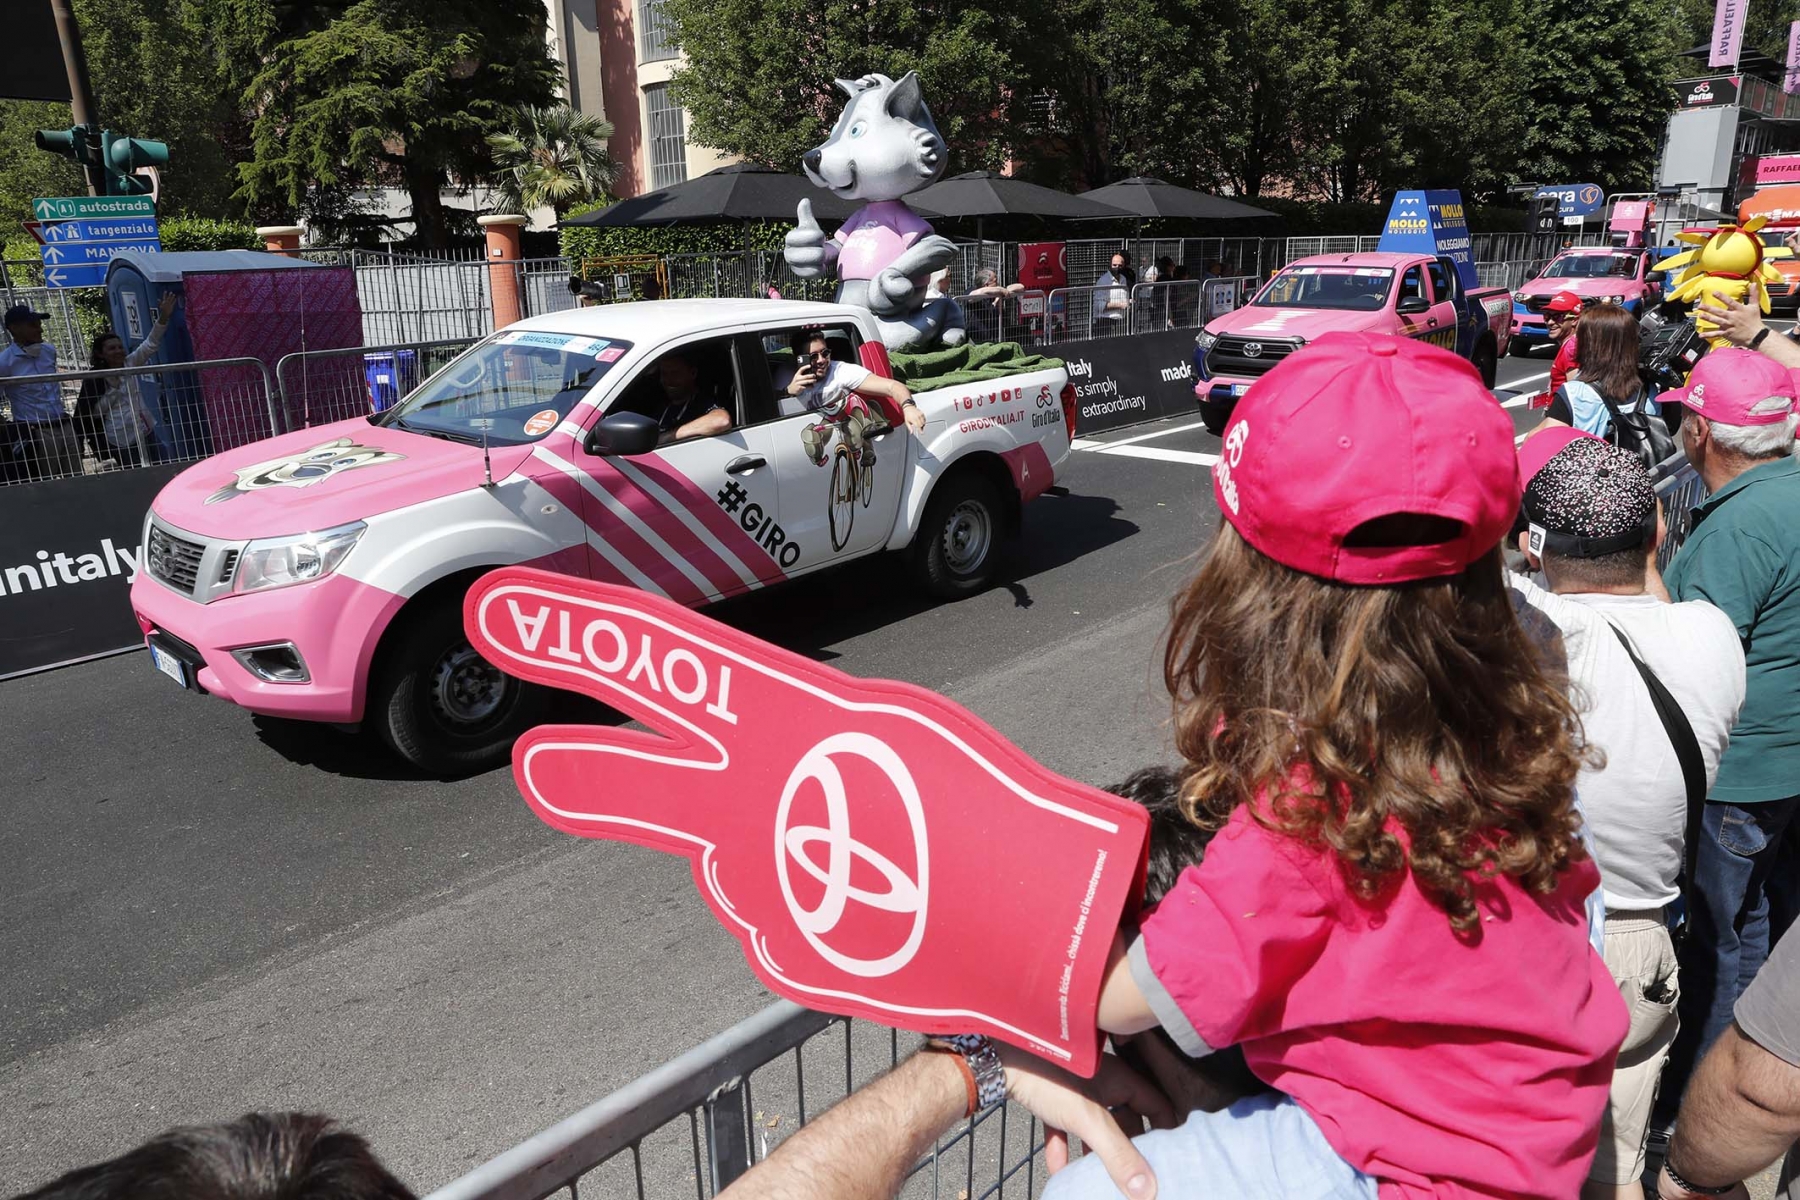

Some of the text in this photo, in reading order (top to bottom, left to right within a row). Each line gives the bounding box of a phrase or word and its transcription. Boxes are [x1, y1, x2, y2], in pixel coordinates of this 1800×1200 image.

[79, 201, 150, 212] autostrada
[1440, 204, 1463, 219] MOLLO
[88, 224, 155, 237] tangenziale
[1389, 219, 1428, 228] MOLLO
[1066, 359, 1092, 378] Italy
[1074, 376, 1117, 397] is simply
[1082, 395, 1146, 418] extraordinary
[960, 410, 1025, 433] GIRODITALIA.IT
[1032, 413, 1044, 428] Giro
[717, 480, 801, 568] #GIRO
[506, 598, 738, 725] TOYOTA
[1072, 913, 1088, 936] dove
[1081, 848, 1108, 907] incontreremo!
